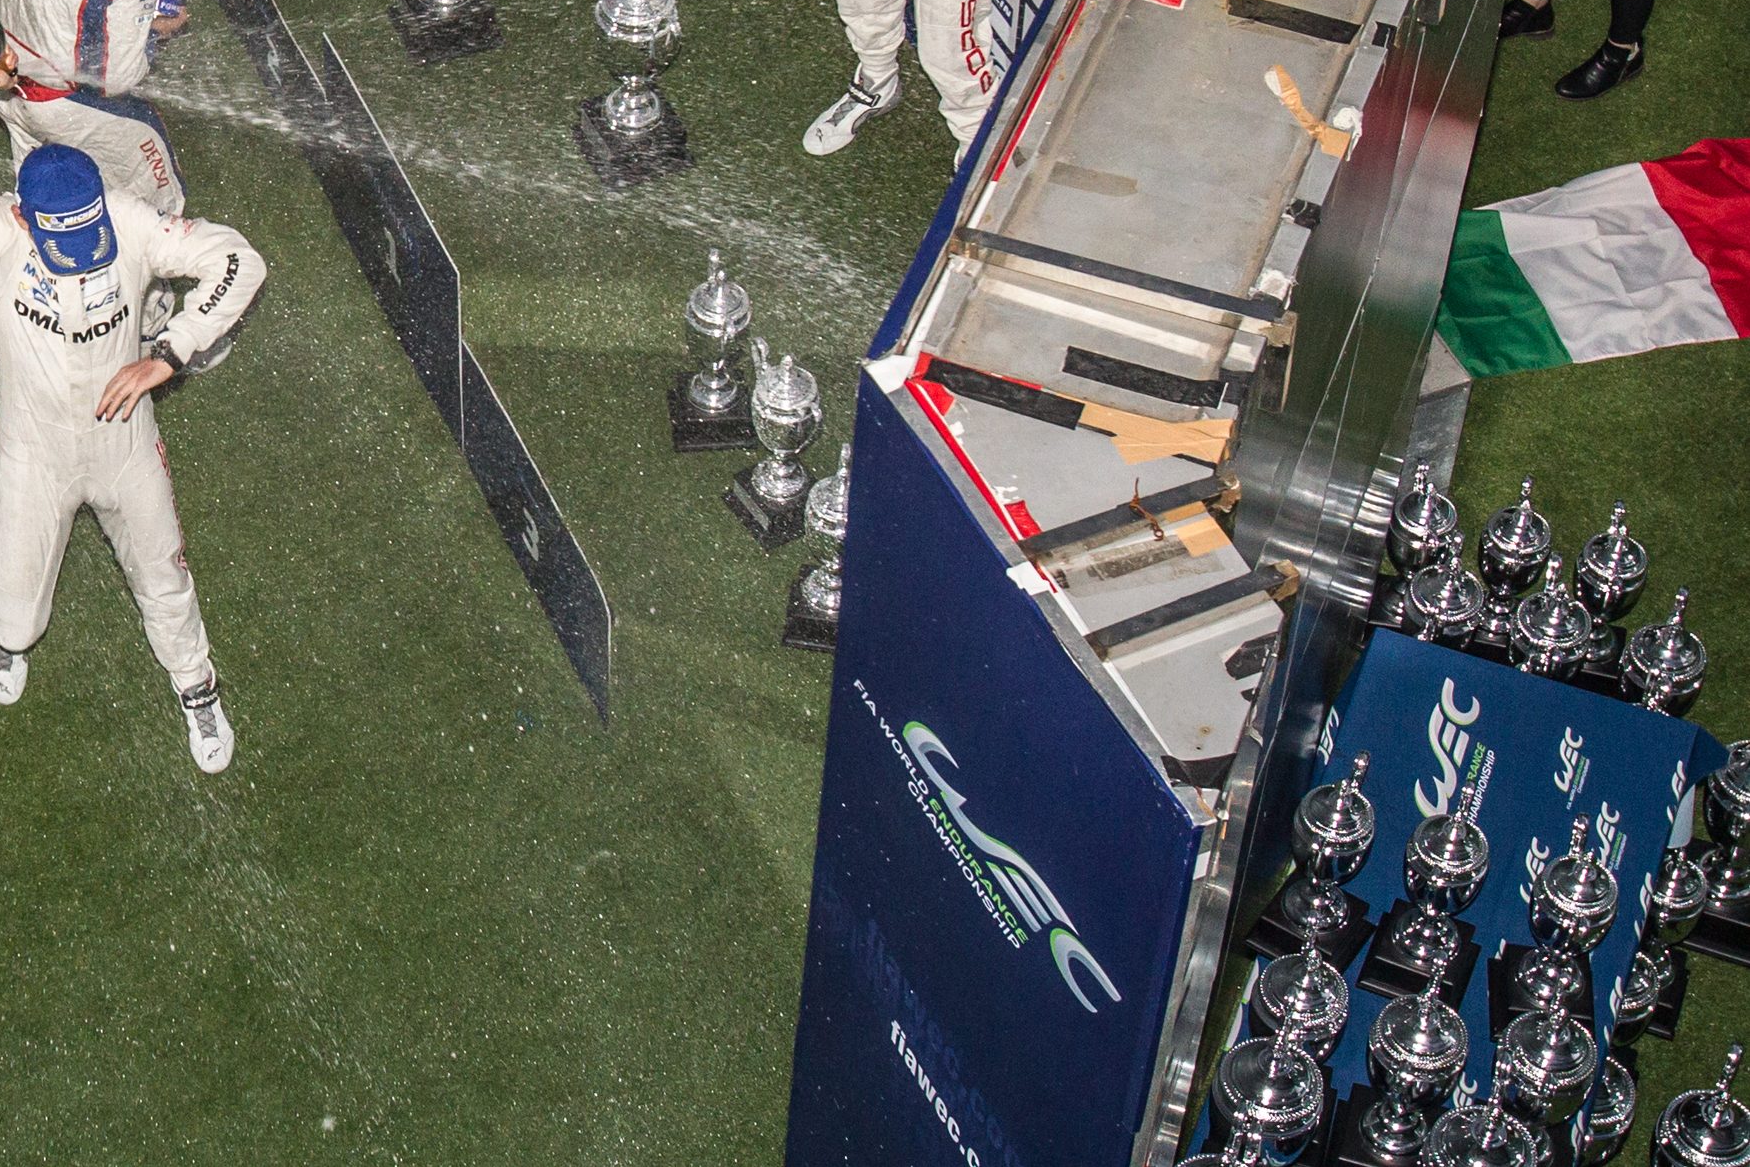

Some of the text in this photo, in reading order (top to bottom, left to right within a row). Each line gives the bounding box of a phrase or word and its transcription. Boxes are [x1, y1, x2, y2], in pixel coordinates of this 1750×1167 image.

[139, 137, 170, 190] DENSO
[223, 253, 240, 287] MOR
[72, 304, 129, 343] MORI
[1414, 677, 1481, 818] WEC
[1554, 726, 1583, 792] WEC
[853, 679, 1029, 944] FIA WORLD ENDURANCE
[1468, 749, 1495, 825] HAMPIONSHIP
[902, 720, 1122, 1013] WEC
[907, 780, 1020, 950] CHAMPIONSHIP
